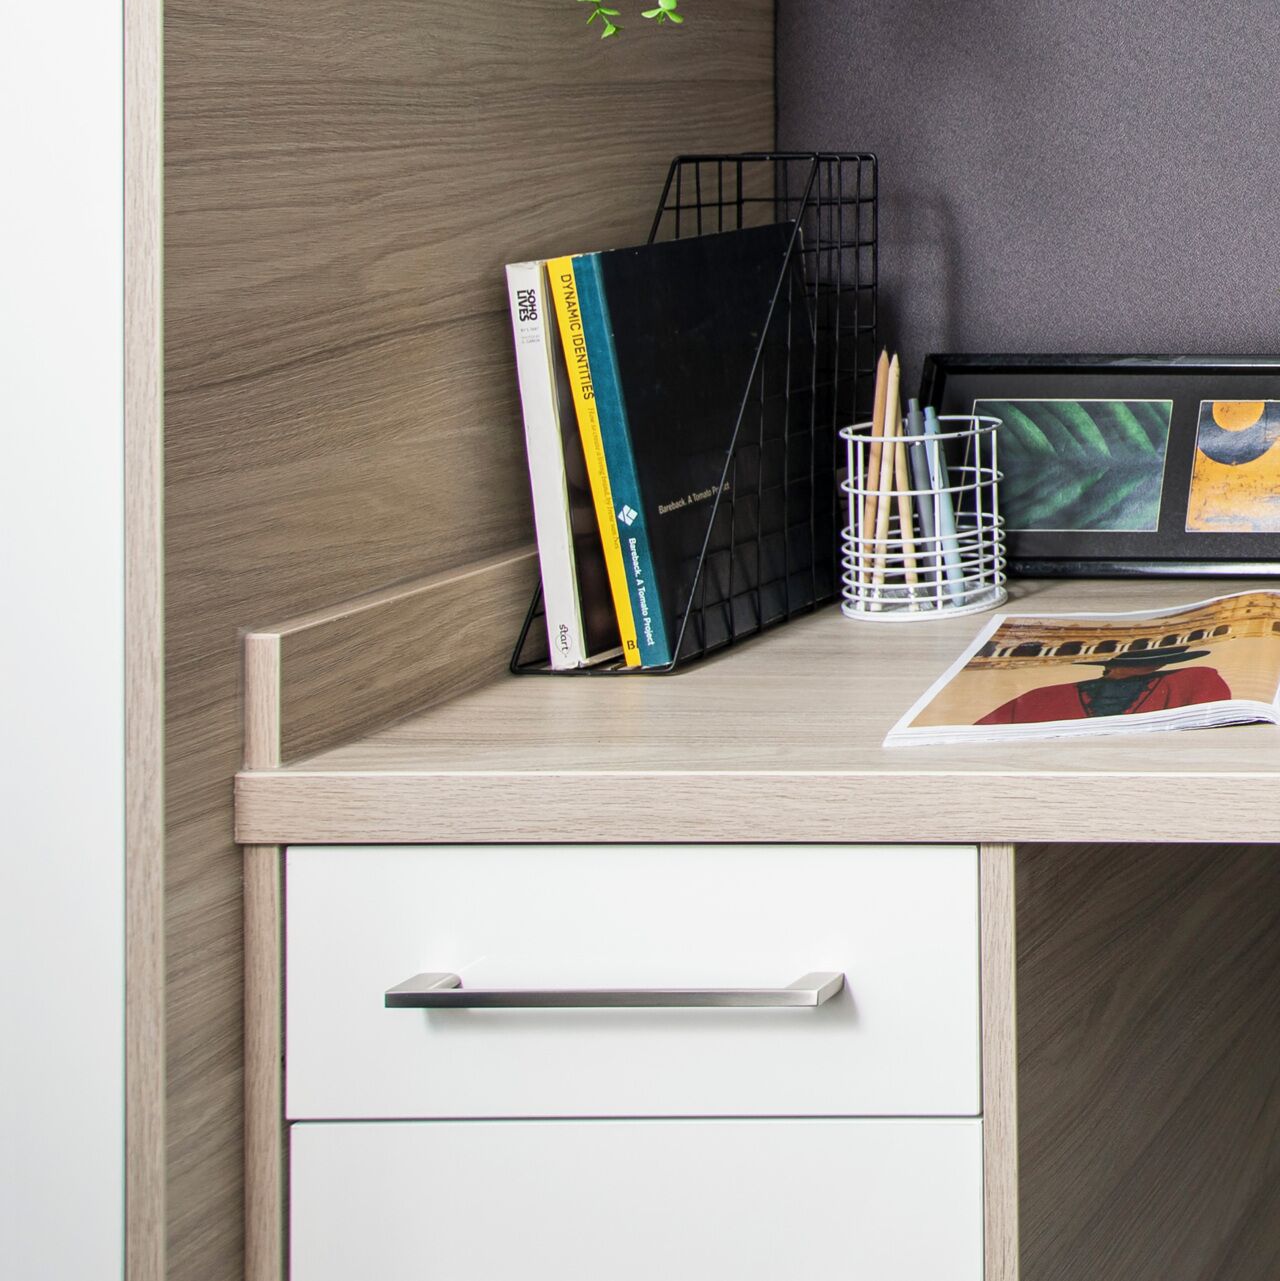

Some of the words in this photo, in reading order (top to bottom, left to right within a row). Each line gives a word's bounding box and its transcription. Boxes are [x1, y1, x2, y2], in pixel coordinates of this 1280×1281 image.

[517, 290, 530, 322] LIVES
[526, 289, 538, 321] SOHO
[560, 273, 581, 331] DYNAMIC
[571, 333, 594, 401] IDENTITIES
[711, 481, 730, 495] Prct
[628, 538, 641, 577] Bareback.
[638, 586, 649, 617] Tomato
[644, 617, 655, 646] Project
